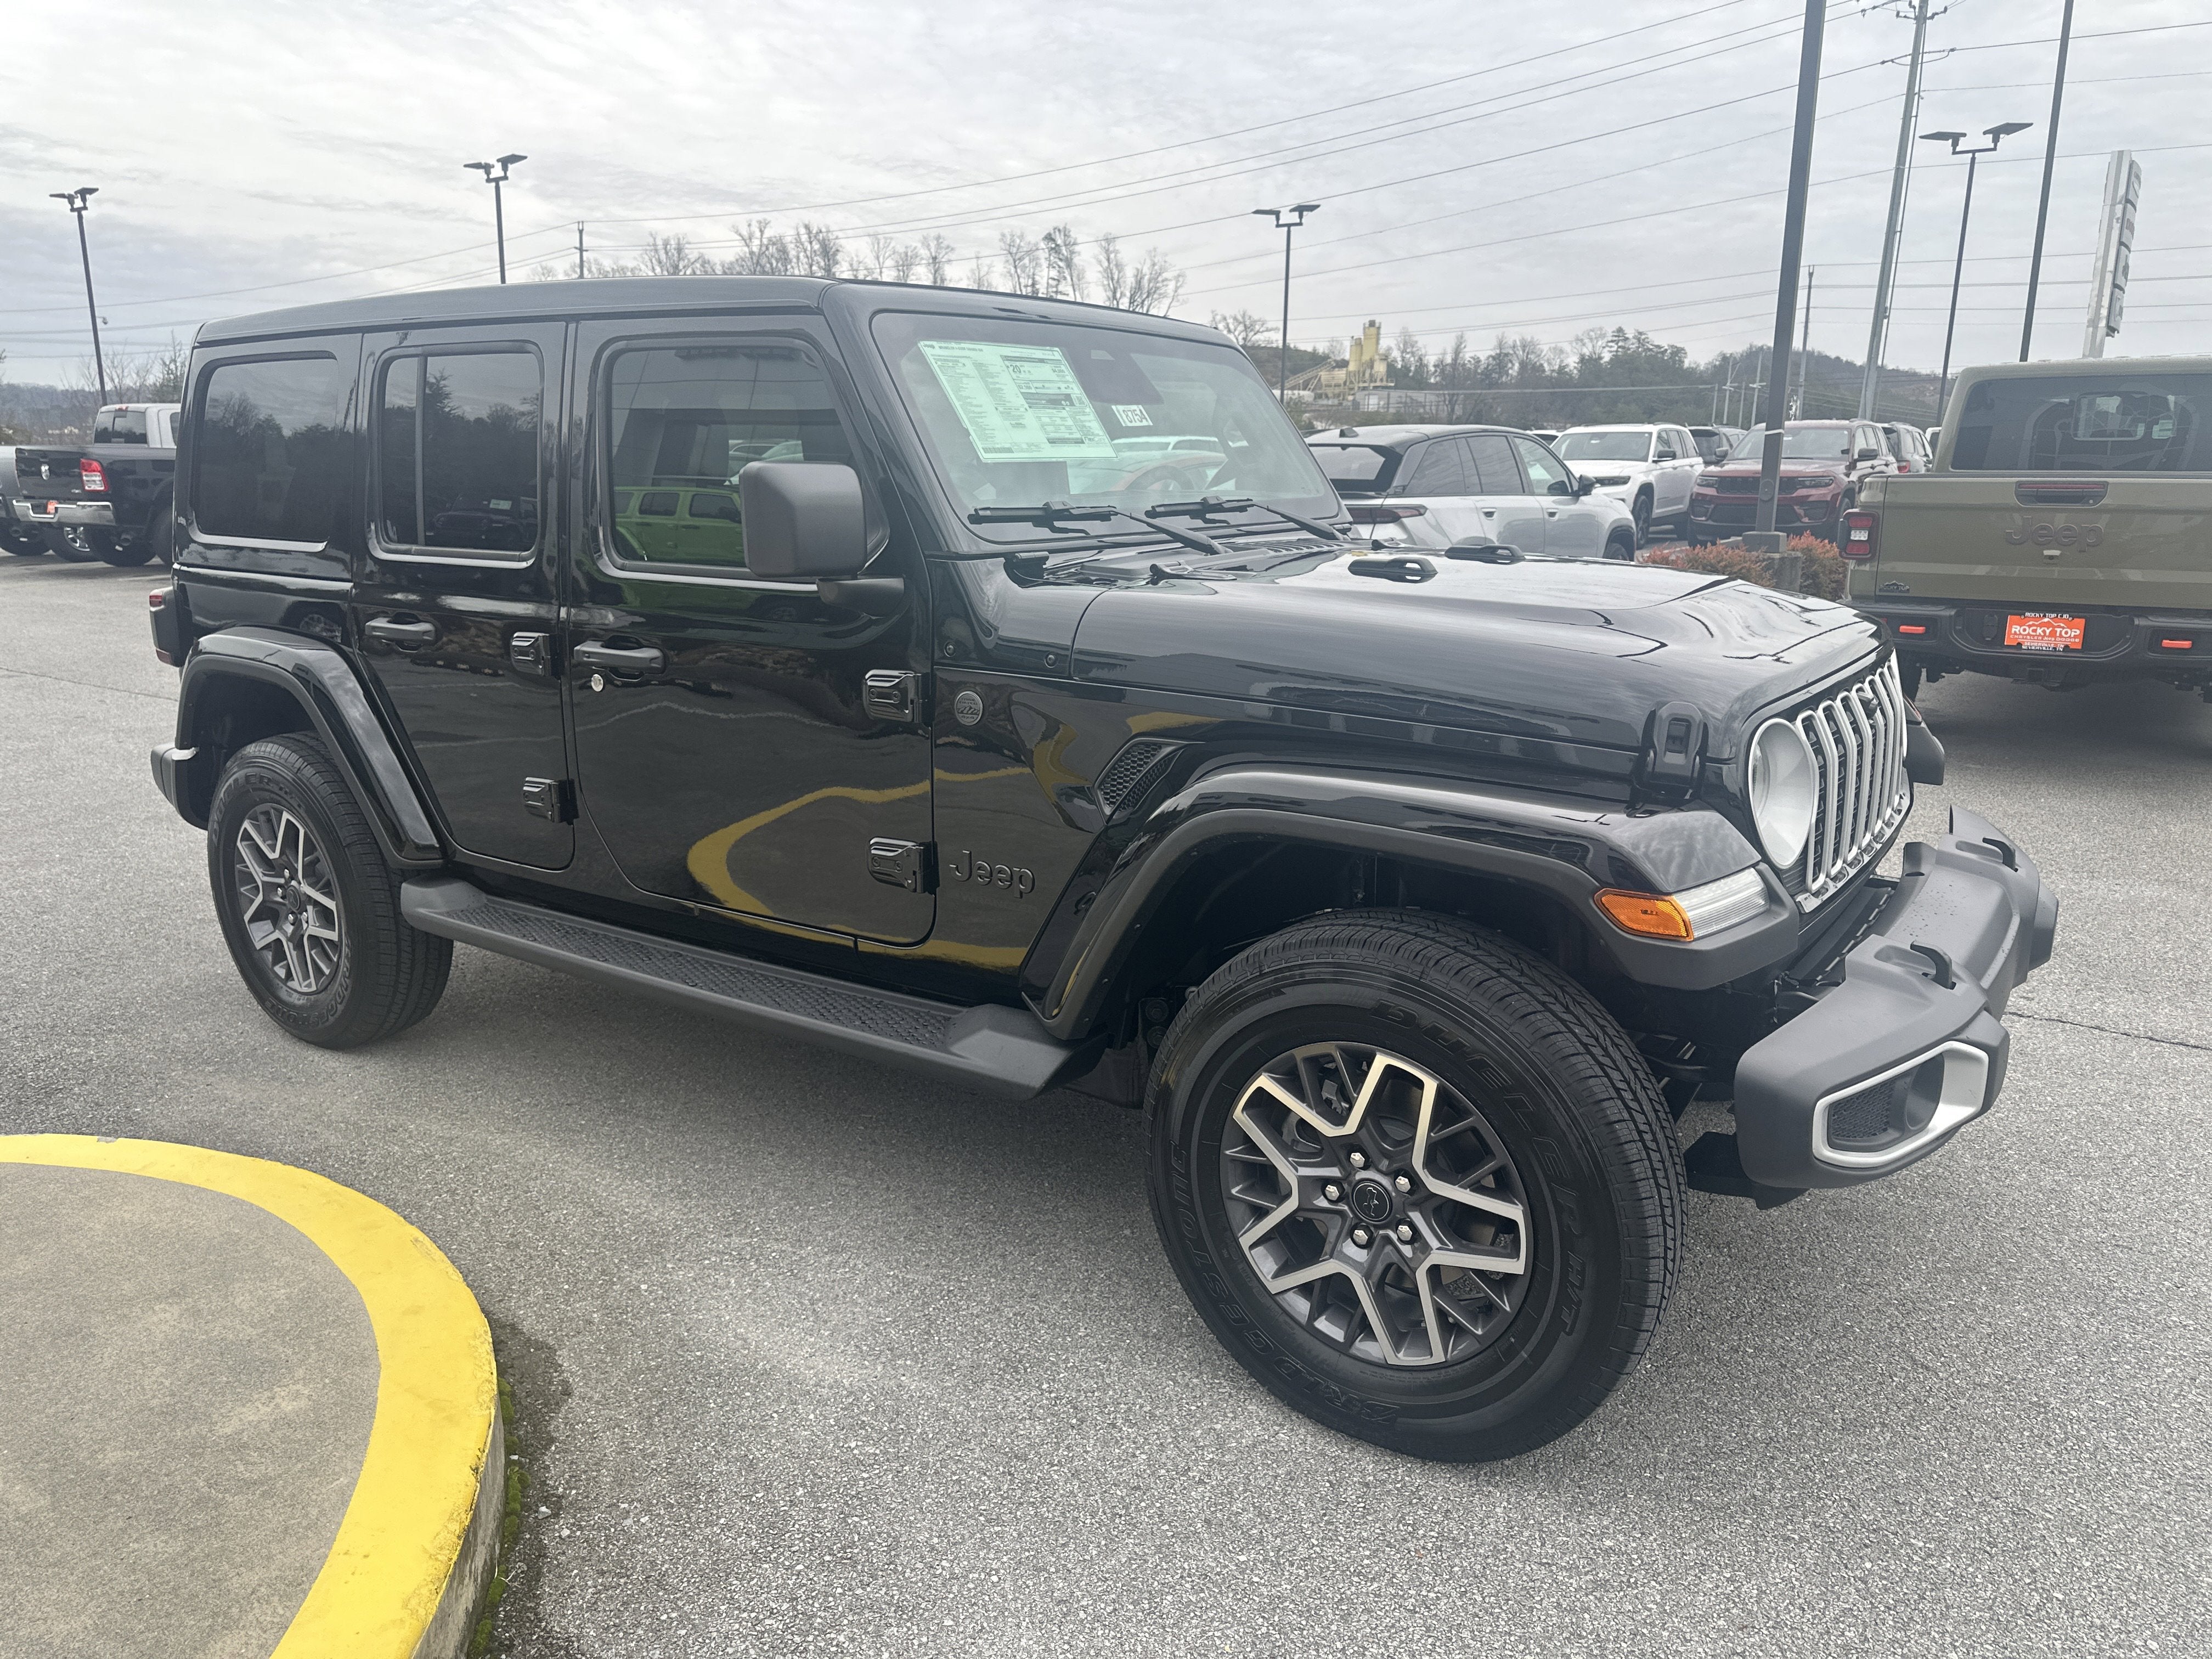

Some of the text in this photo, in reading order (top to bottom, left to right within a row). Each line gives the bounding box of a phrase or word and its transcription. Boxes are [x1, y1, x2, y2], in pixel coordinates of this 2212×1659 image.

[1010, 364, 1021, 373] 20
[1122, 409, 1148, 424] 8754
[2005, 516, 2104, 553] Jeep
[2011, 625, 2080, 637] ROCKY TOP
[950, 850, 1035, 899] Jeep
[1369, 998, 1583, 1235] DUELER
[1168, 1138, 1402, 1429] BRIDGESTONE
